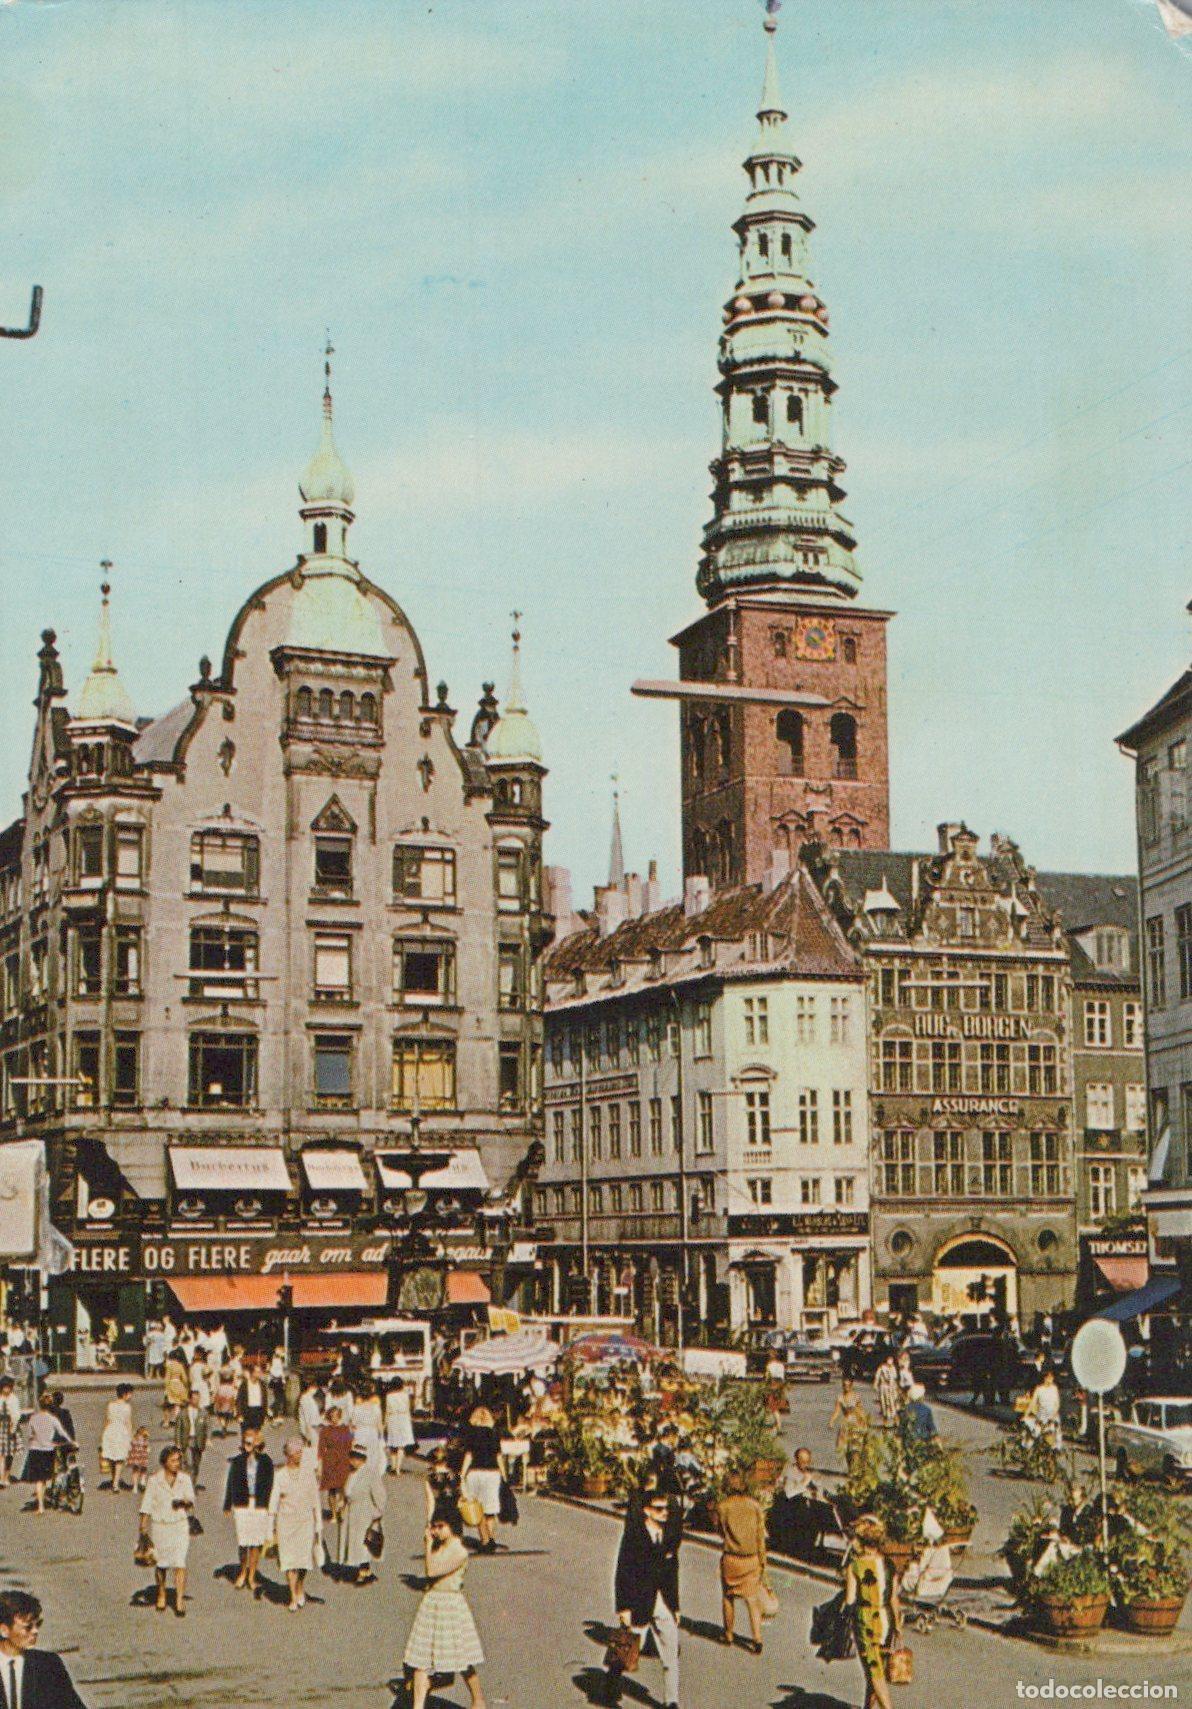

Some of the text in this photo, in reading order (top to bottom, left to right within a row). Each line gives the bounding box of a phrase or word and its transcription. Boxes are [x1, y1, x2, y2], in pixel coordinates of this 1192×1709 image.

[962, 1015, 1031, 1038] BORGEN
[932, 1098, 1018, 1113] ASSURANCE
[70, 1248, 130, 1271] FLERE
[144, 1246, 175, 1270] OG
[188, 1245, 251, 1269] FLERE
[319, 1248, 352, 1263] om
[361, 1242, 389, 1262] ad
